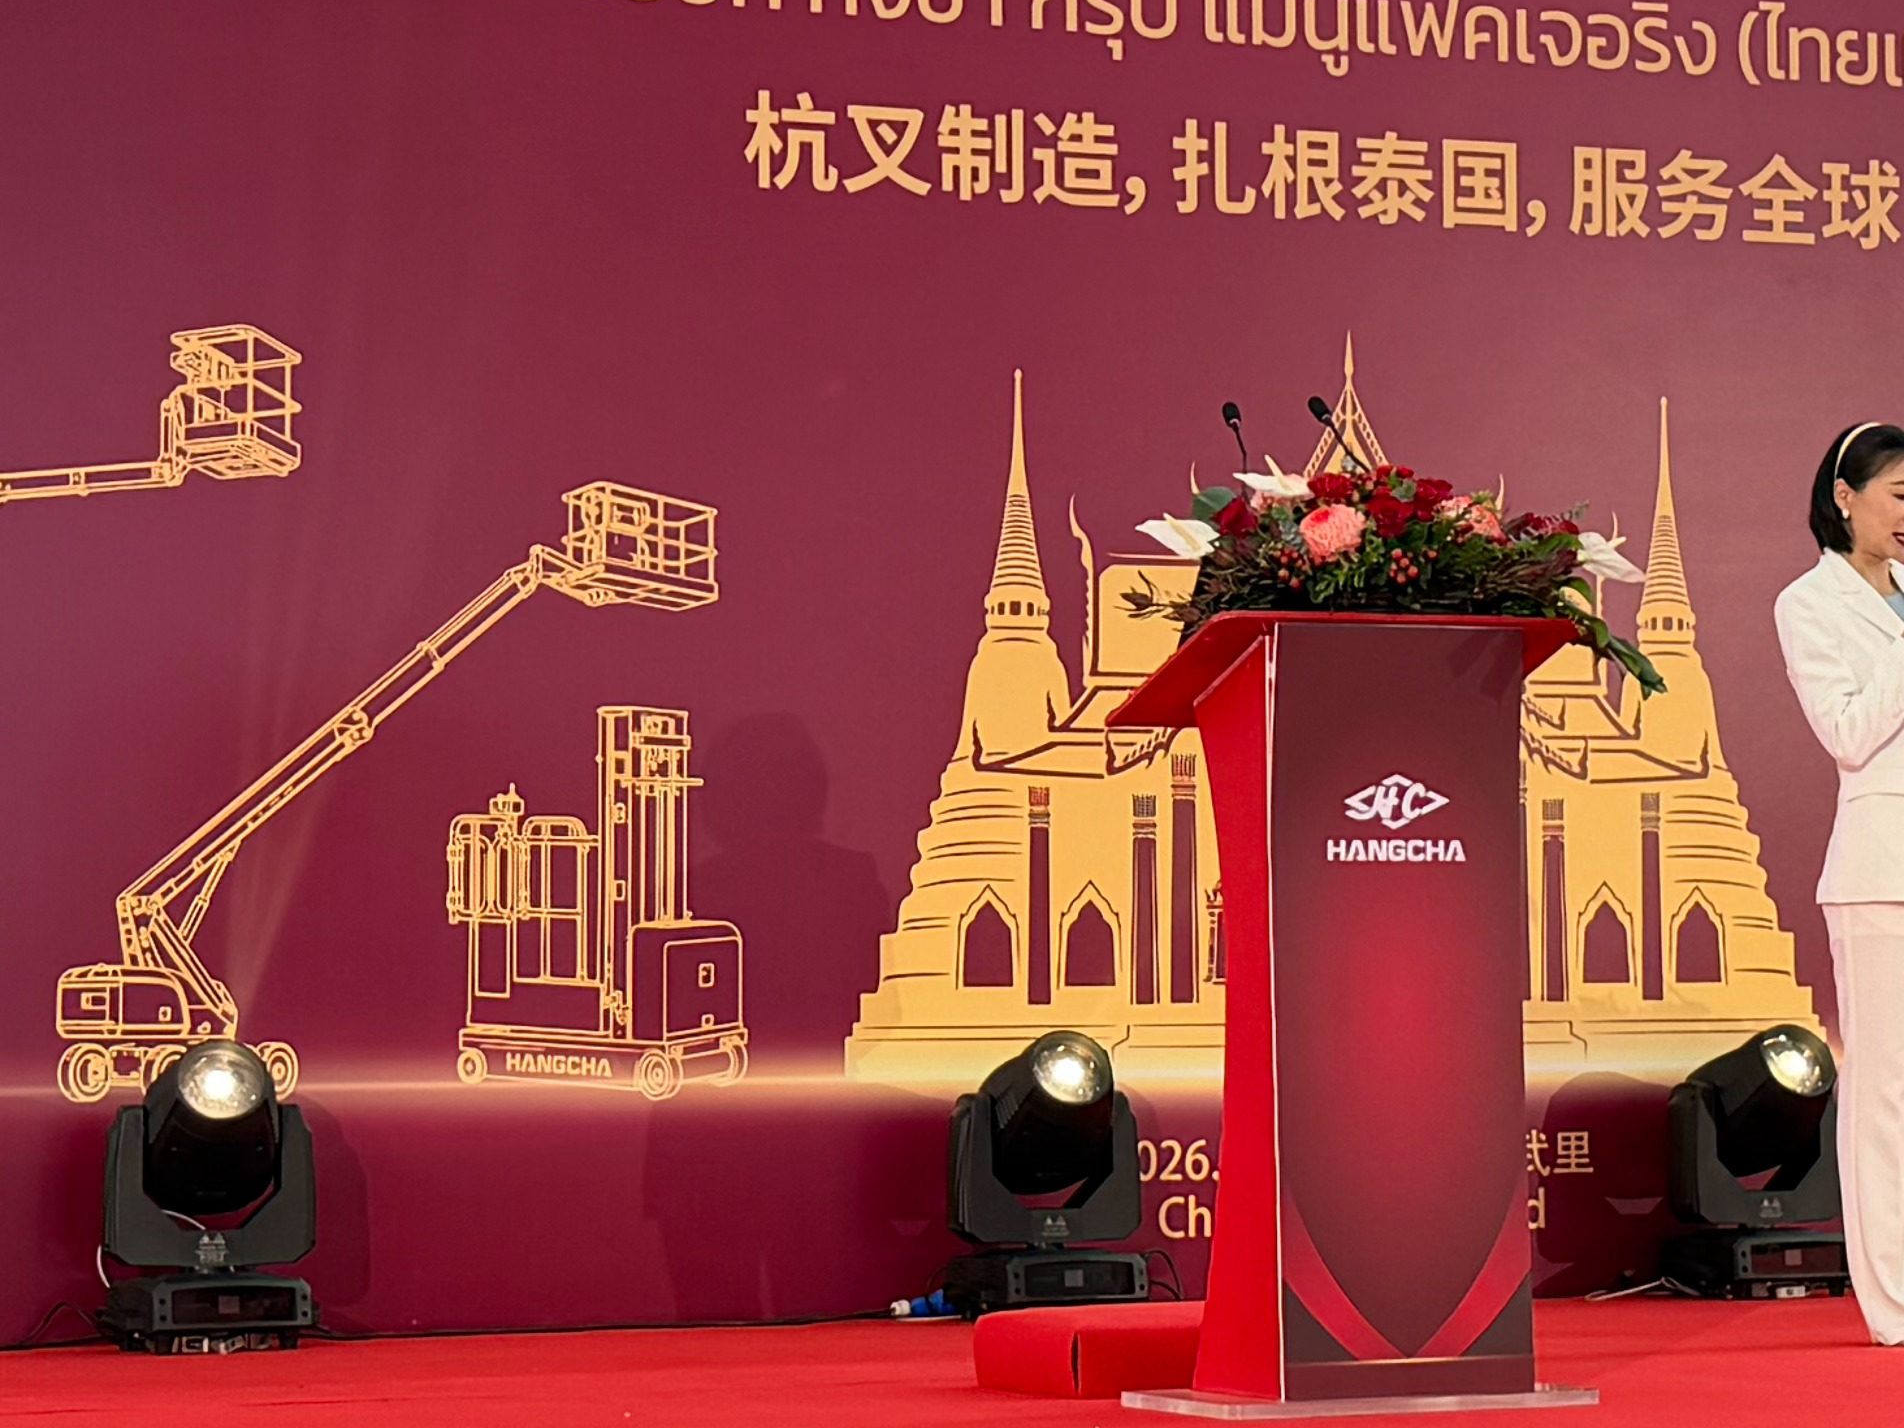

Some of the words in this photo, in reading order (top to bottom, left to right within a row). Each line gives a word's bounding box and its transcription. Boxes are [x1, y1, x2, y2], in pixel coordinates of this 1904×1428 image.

[1569, 146, 1903, 252] 服务全球
[1327, 839, 1466, 862] HANGCHA
[505, 1052, 613, 1078] HANGCHA
[1525, 1129, 1594, 1177] 武里
